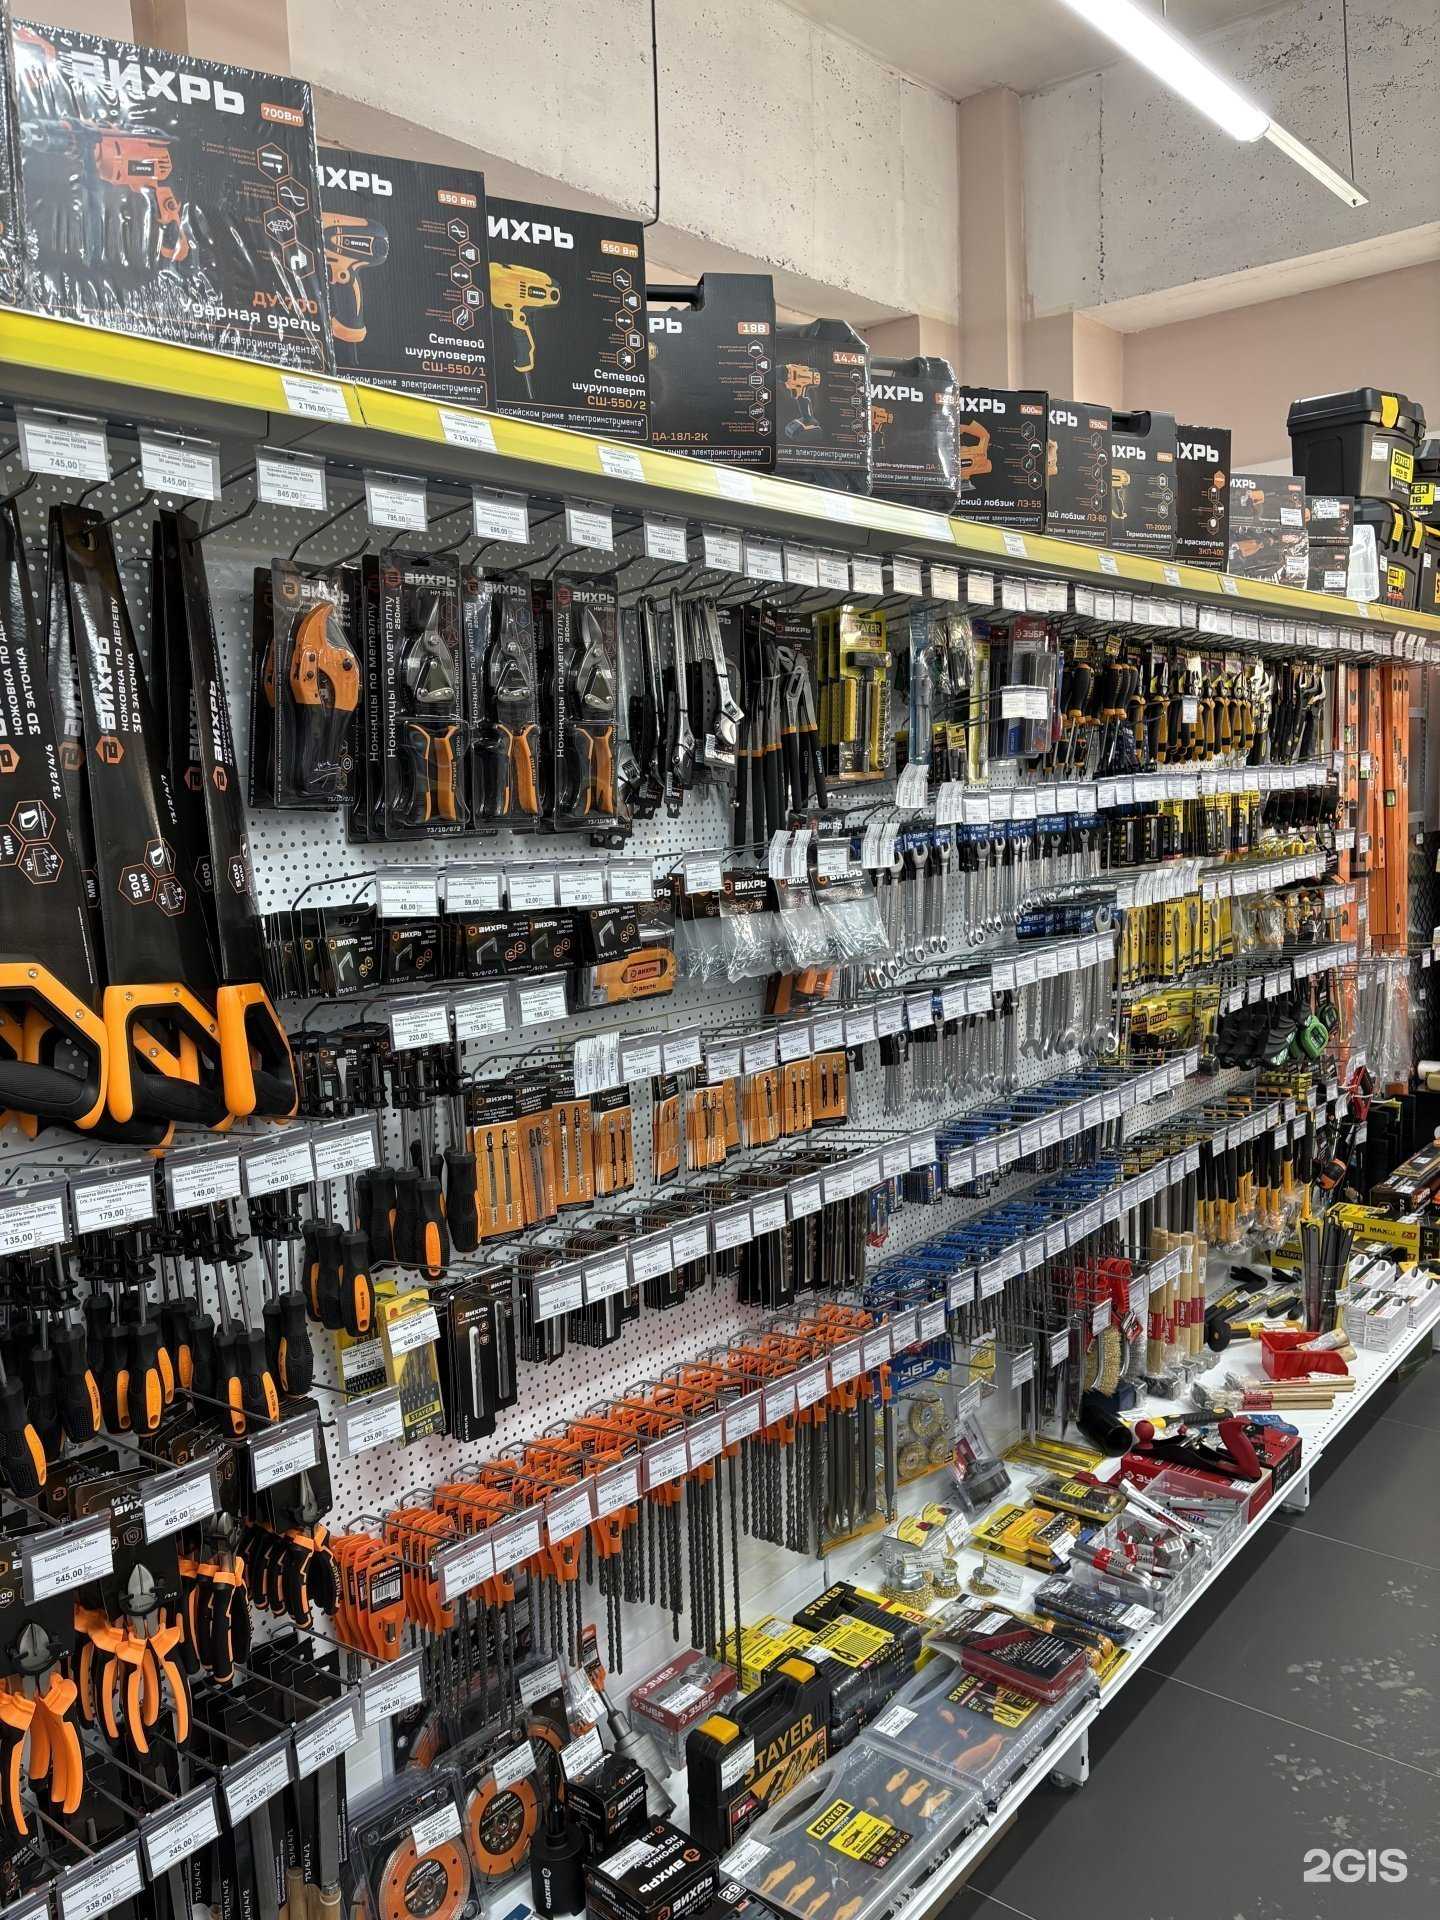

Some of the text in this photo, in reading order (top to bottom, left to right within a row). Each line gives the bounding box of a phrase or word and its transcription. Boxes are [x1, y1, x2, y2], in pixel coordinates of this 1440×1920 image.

[268, 314, 321, 333] дрель
[428, 333, 486, 349] Сетевой
[405, 346, 486, 364] шуруповерт
[422, 361, 487, 377] СШ-550/1
[593, 369, 646, 383] Сетевой
[572, 382, 646, 398] шуруповерт
[587, 395, 646, 410] СШ-550/2
[49, 457, 79, 470] 745,00
[404, 572, 457, 588] ВИХРЬ
[484, 582, 527, 597] ВИХРЬ
[572, 591, 615, 604] ВИХРЬ
[110, 596, 122, 647] ДЕРЕВУ
[556, 612, 566, 671] металлу
[97, 636, 118, 731] ВИХРЬ
[385, 596, 399, 758] Ножницы по металлу
[15, 646, 41, 735] 3D ЗАТОЧКА
[127, 652, 143, 734] 3D ЗАТОЧКА
[3, 667, 24, 736] НОЖОВКА
[117, 669, 130, 732] НОЖОВКА
[556, 703, 565, 758] Ножницы
[128, 873, 143, 899] 500
[734, 880, 767, 890] ВИХРЬ
[598, 907, 620, 917] ВИХРЬ
[478, 923, 508, 934] ВИХРЬ
[485, 1094, 514, 1104] ВИХРЬ
[192, 1187, 216, 1198] 149,00
[99, 1208, 124, 1221] 179,00
[4, 1232, 33, 1246] 135,00
[271, 1462, 294, 1477] 395,00
[164, 1510, 189, 1527] 495,00
[55, 1568, 83, 1585] 545,00
[804, 1586, 845, 1616] STAYER
[647, 1666, 675, 1689] ЗУБР
[948, 1675, 978, 1702] STAYER
[639, 1702, 665, 1721] ЗУБР
[688, 1691, 715, 1718] ЗУБР
[617, 1785, 644, 1811] ВИХРЬ
[815, 1804, 847, 1833] STAYER
[644, 1839, 686, 1869] КОРОНКА
[638, 1859, 687, 1894] ВИХРЬ
[672, 1876, 714, 1913] ВИХРЬ
[722, 1884, 741, 1899] 29
[84, 1892, 112, 1914] 338,00
